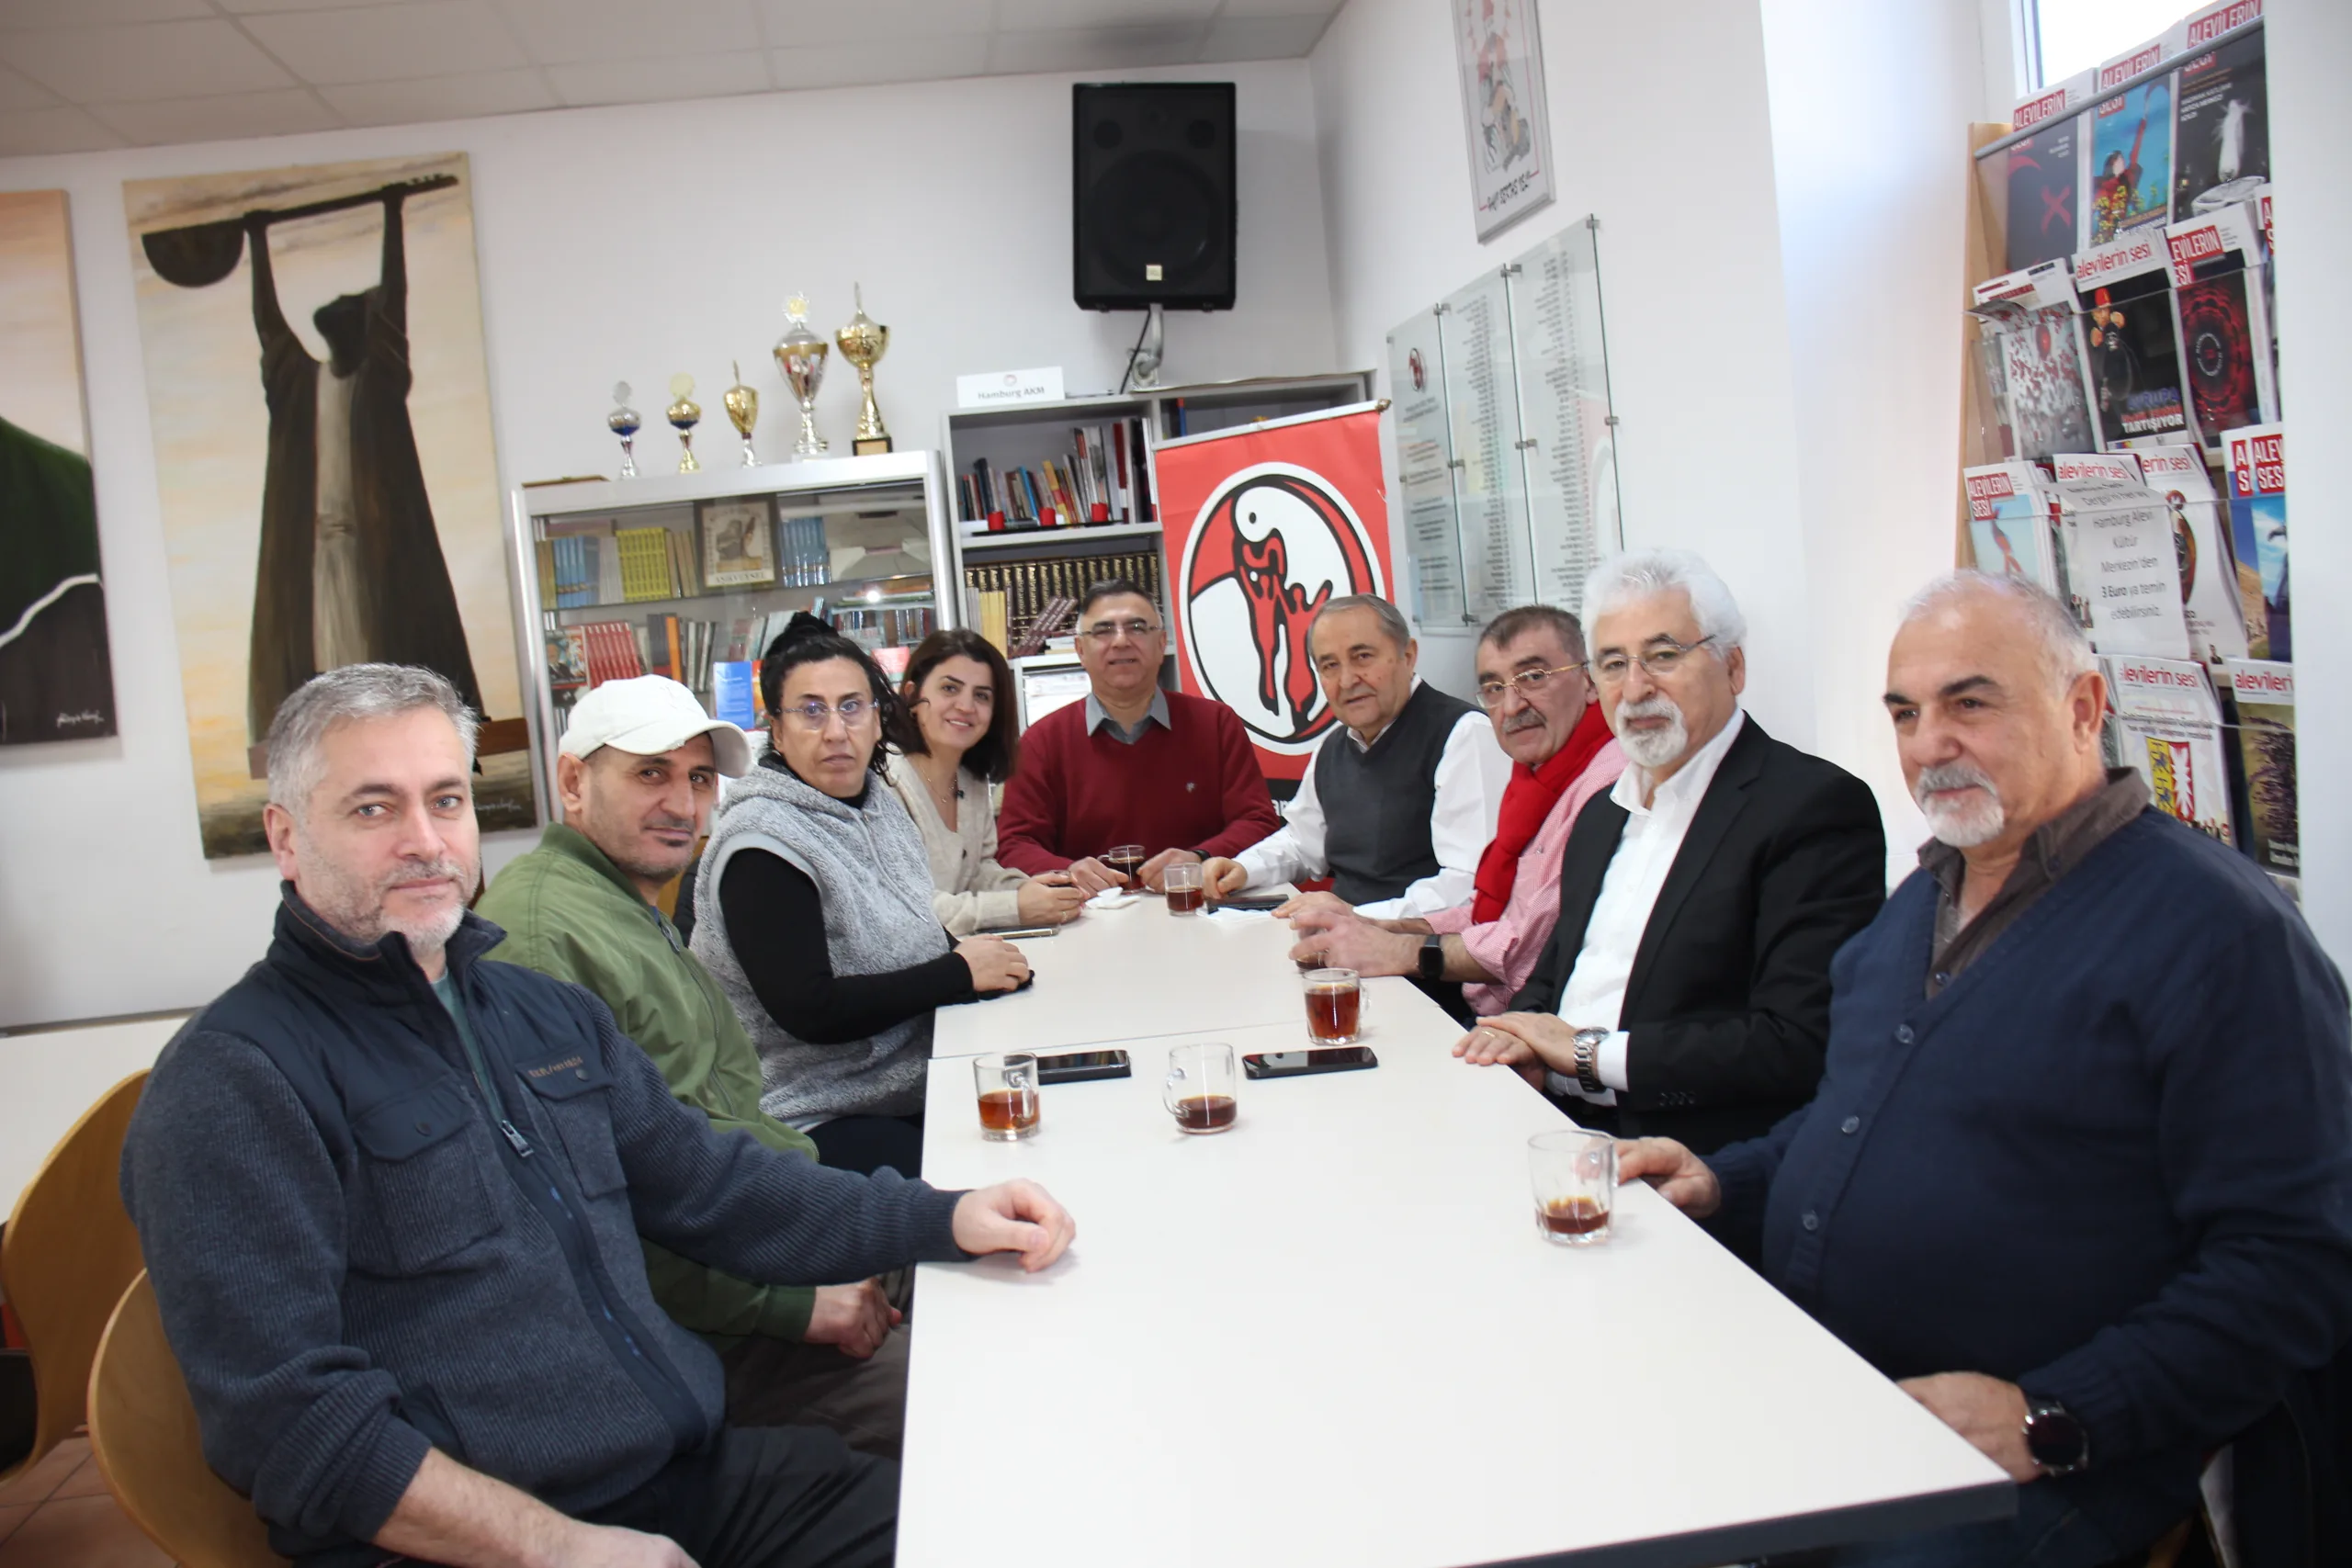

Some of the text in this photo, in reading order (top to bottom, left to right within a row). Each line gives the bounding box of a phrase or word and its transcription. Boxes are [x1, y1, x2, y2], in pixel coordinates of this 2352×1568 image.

[2075, 249, 2129, 279] alevilerin
[2130, 240, 2153, 263] sesi
[2170, 228, 2222, 262] EVİLERİN
[978, 386, 1045, 399] Hamburg AKM
